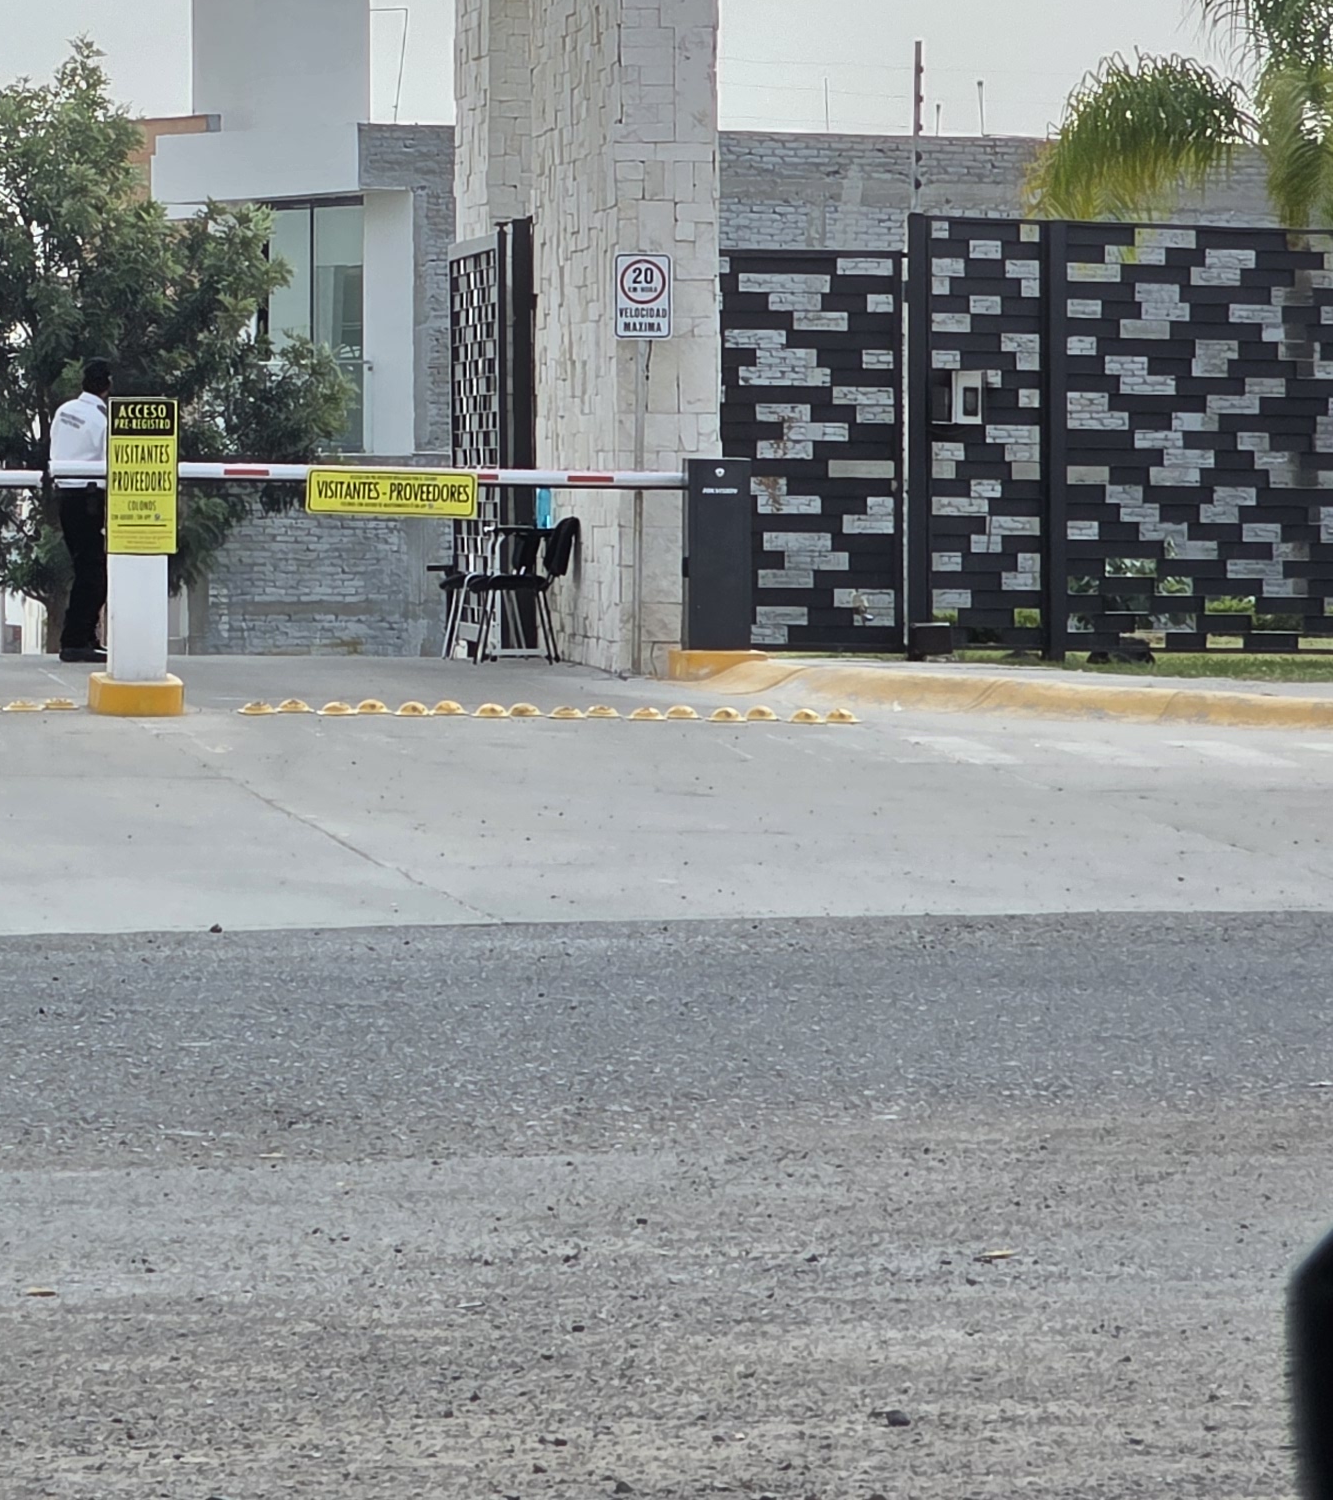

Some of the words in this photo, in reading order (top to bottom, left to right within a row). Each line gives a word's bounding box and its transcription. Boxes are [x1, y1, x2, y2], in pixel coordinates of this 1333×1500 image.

[632, 267, 654, 284] 20
[619, 307, 667, 319] VELOCIDAD
[623, 321, 662, 332] MAXIMA
[118, 404, 167, 418] ACCESO
[114, 418, 171, 429] PRE-REGISTRO
[114, 444, 170, 464] VISITANTES
[112, 470, 172, 492] PROVEEDORES
[317, 480, 380, 500] VISITANTES
[389, 482, 470, 503] PROVEEDORES
[128, 500, 157, 511] COLONOS
